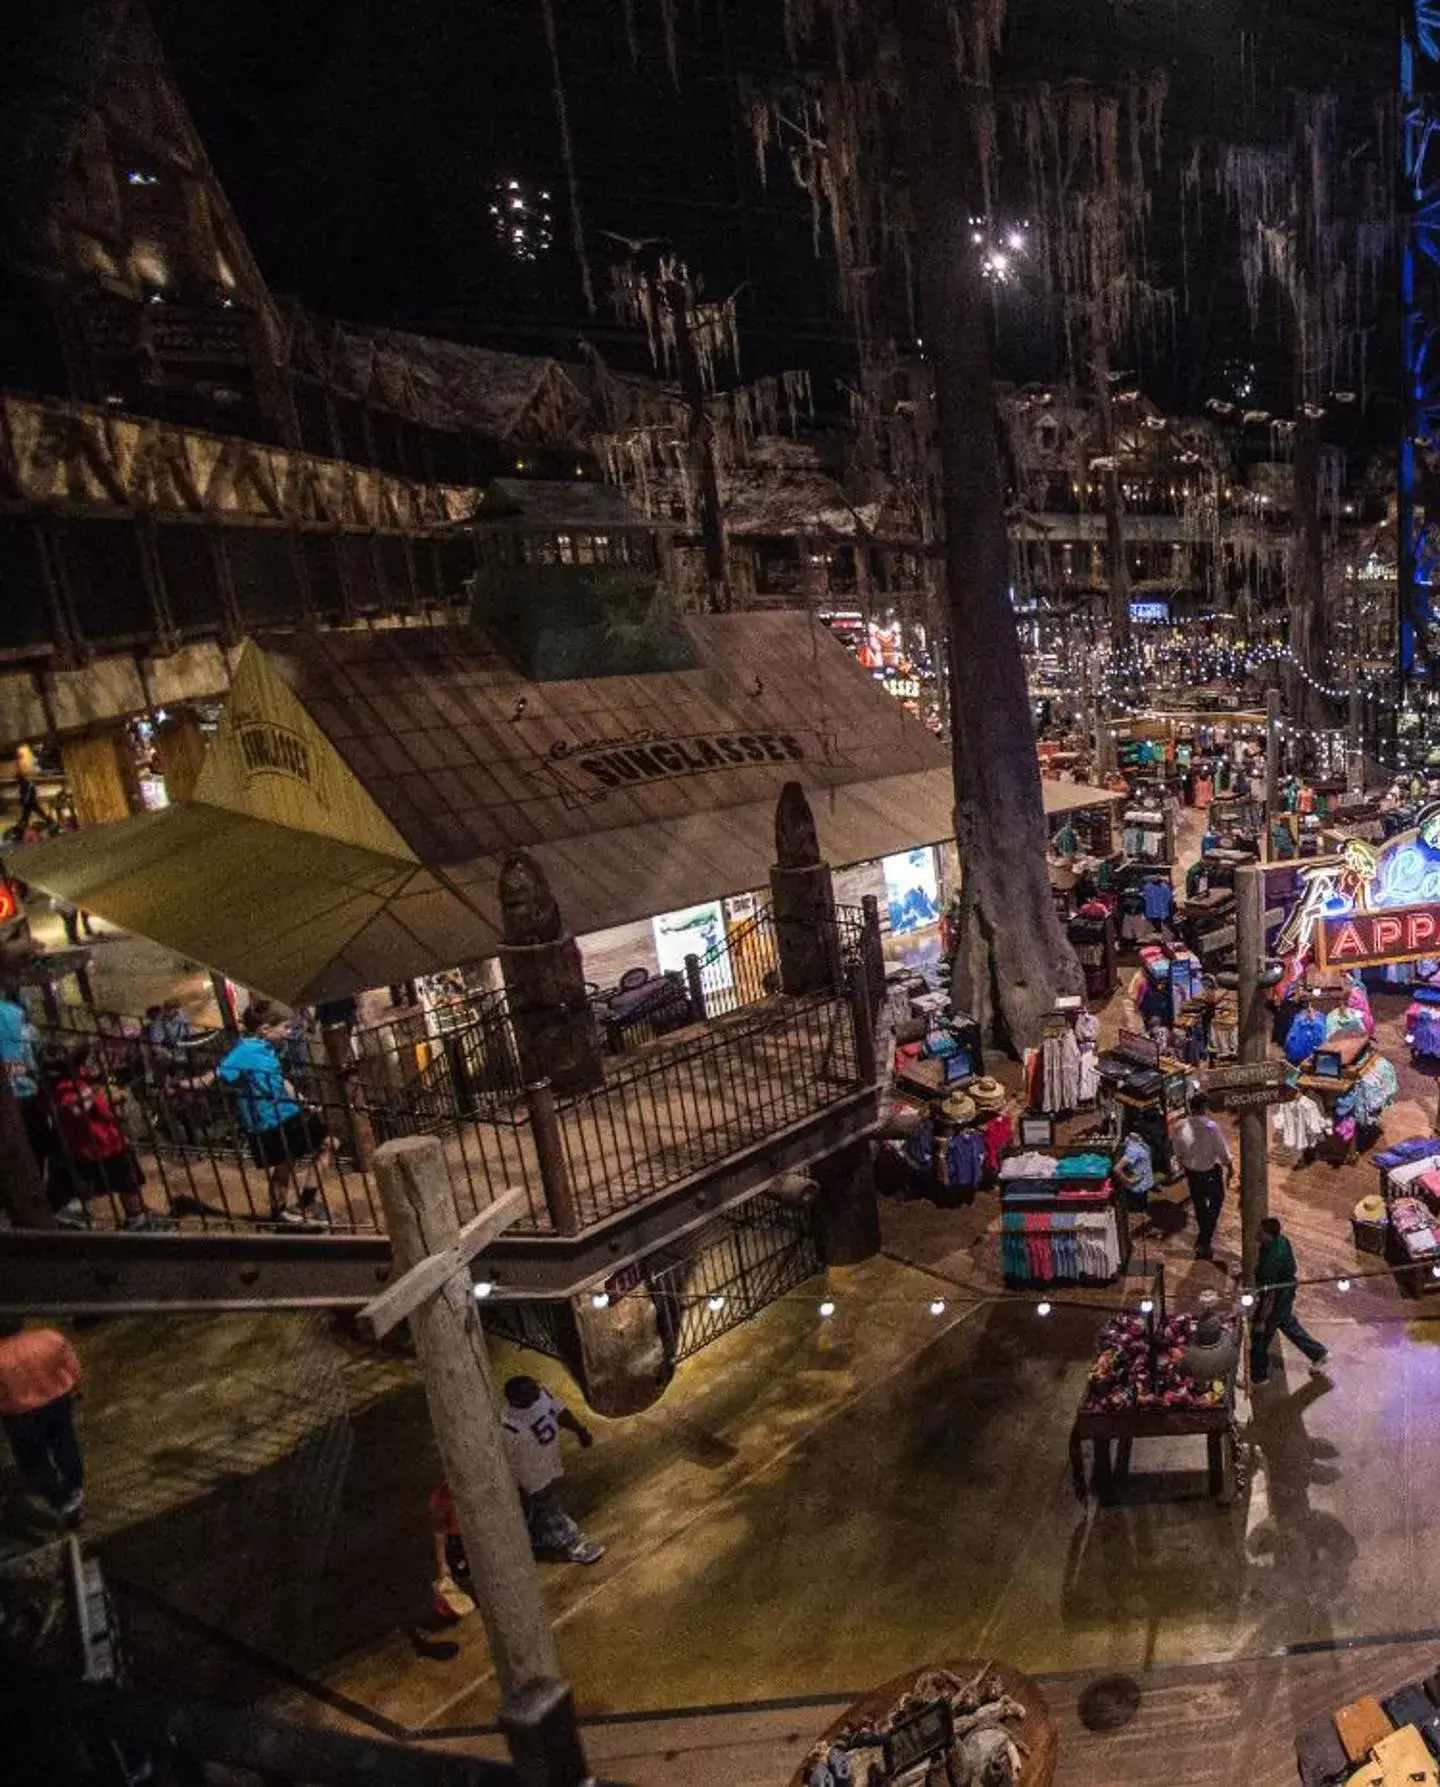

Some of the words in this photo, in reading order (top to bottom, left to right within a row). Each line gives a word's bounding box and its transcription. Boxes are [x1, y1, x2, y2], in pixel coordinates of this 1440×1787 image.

[580, 733, 806, 787] SUNGLASSES
[1223, 1088, 1280, 1107] ARCHERY
[530, 1414, 556, 1446] 5
